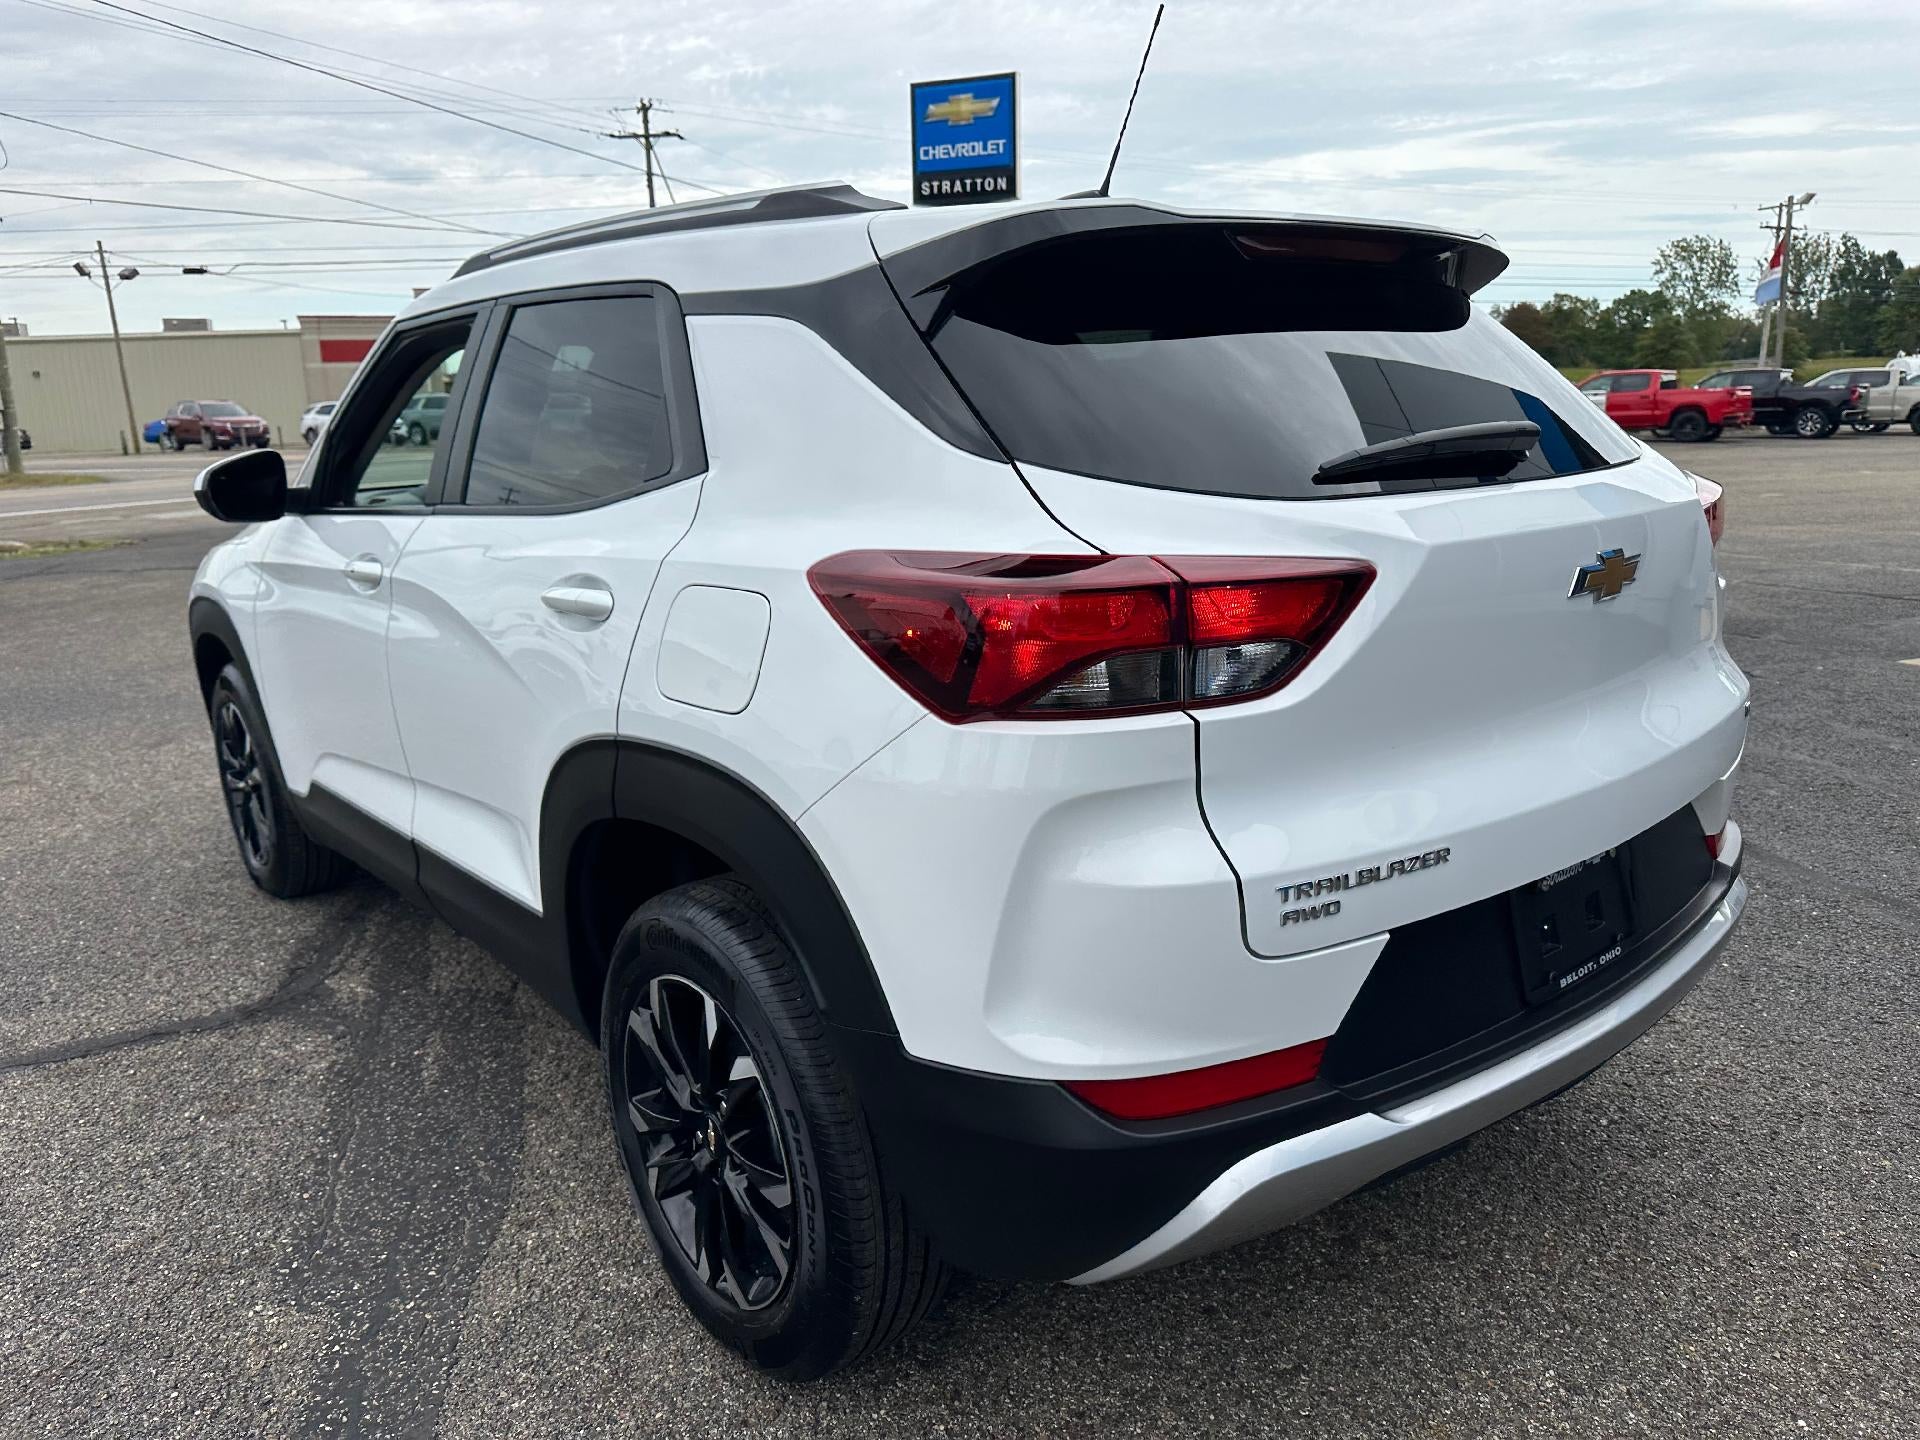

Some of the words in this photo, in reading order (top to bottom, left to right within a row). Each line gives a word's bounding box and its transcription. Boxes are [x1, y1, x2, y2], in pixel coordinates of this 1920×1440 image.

[919, 139, 1007, 161] CHEVROLET
[920, 176, 1007, 196] STRATTON
[1274, 847, 1451, 904] TRAILBLAZER
[1279, 900, 1341, 927] AWD
[1559, 961, 1597, 988] BELOIT,
[1599, 946, 1622, 965] OHIO
